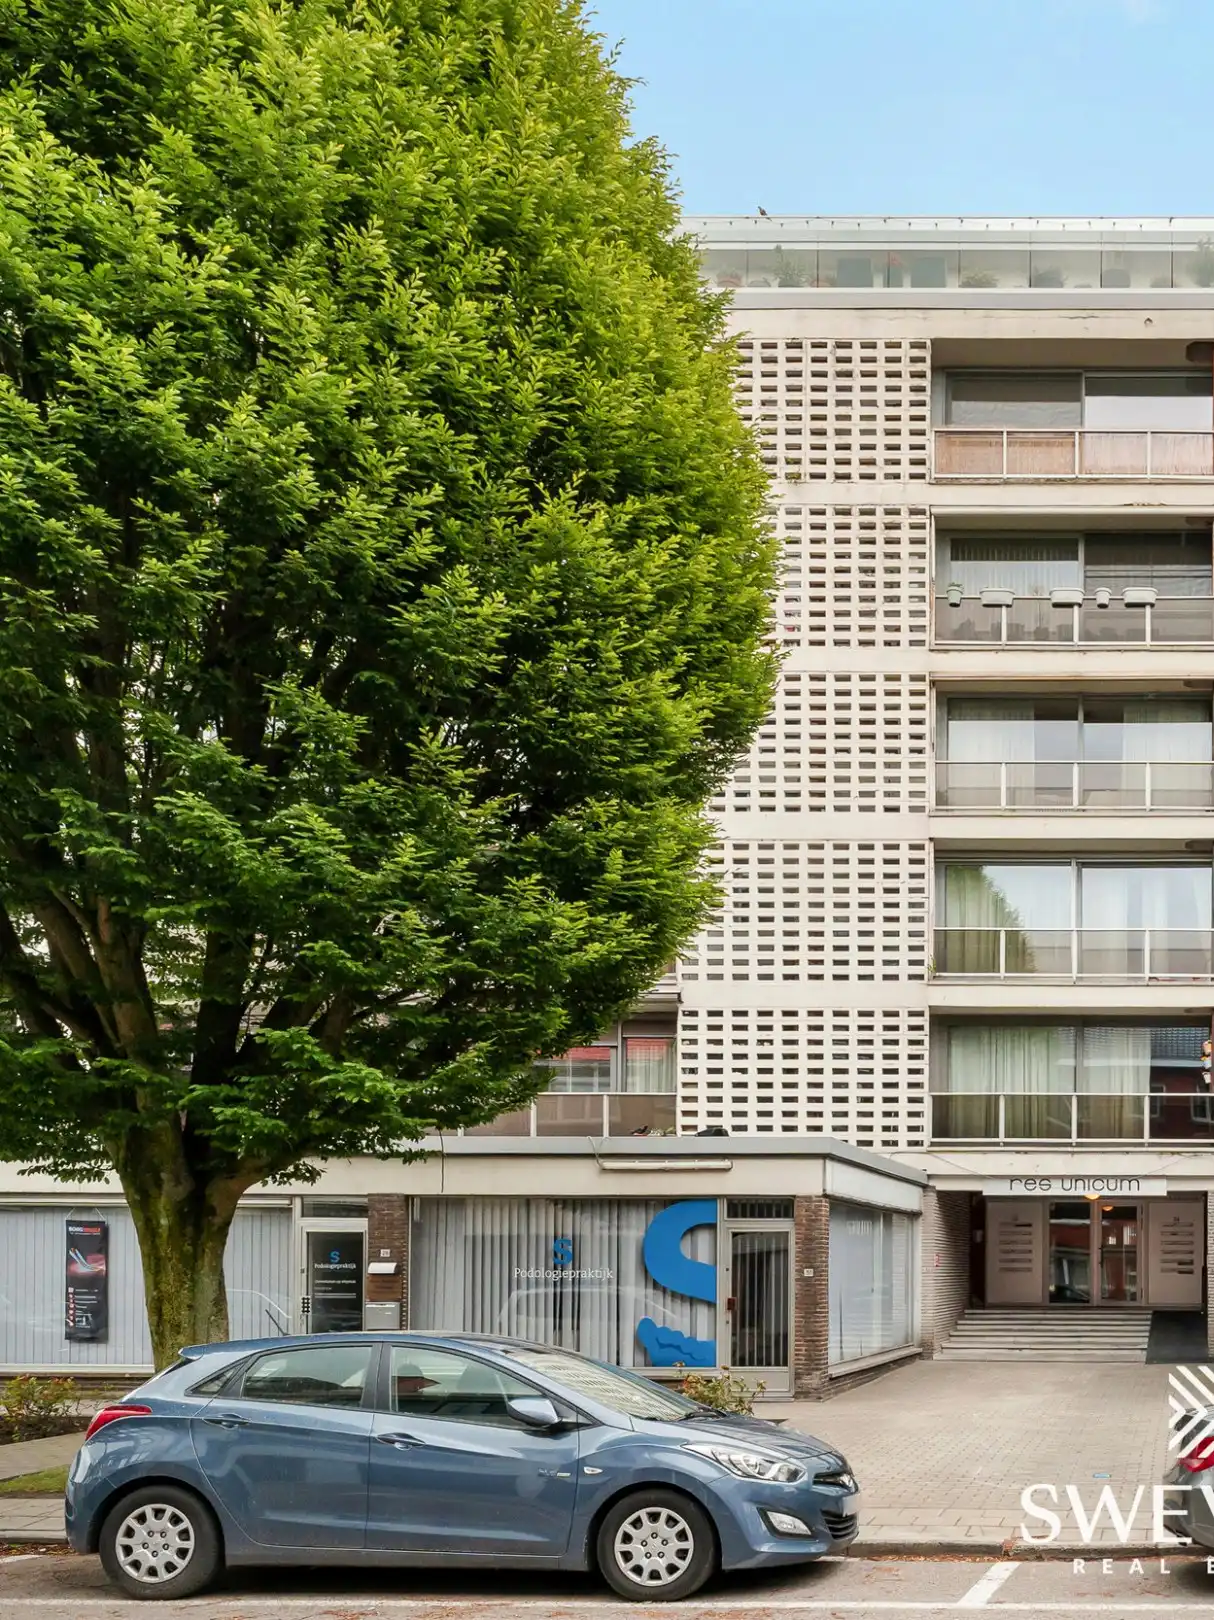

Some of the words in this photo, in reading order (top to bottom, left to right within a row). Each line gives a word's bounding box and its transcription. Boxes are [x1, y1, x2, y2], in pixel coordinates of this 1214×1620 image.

[1010, 1178, 1051, 1191] res
[1061, 1178, 1140, 1191] unicum
[514, 1268, 614, 1280] Podologiepraktijk
